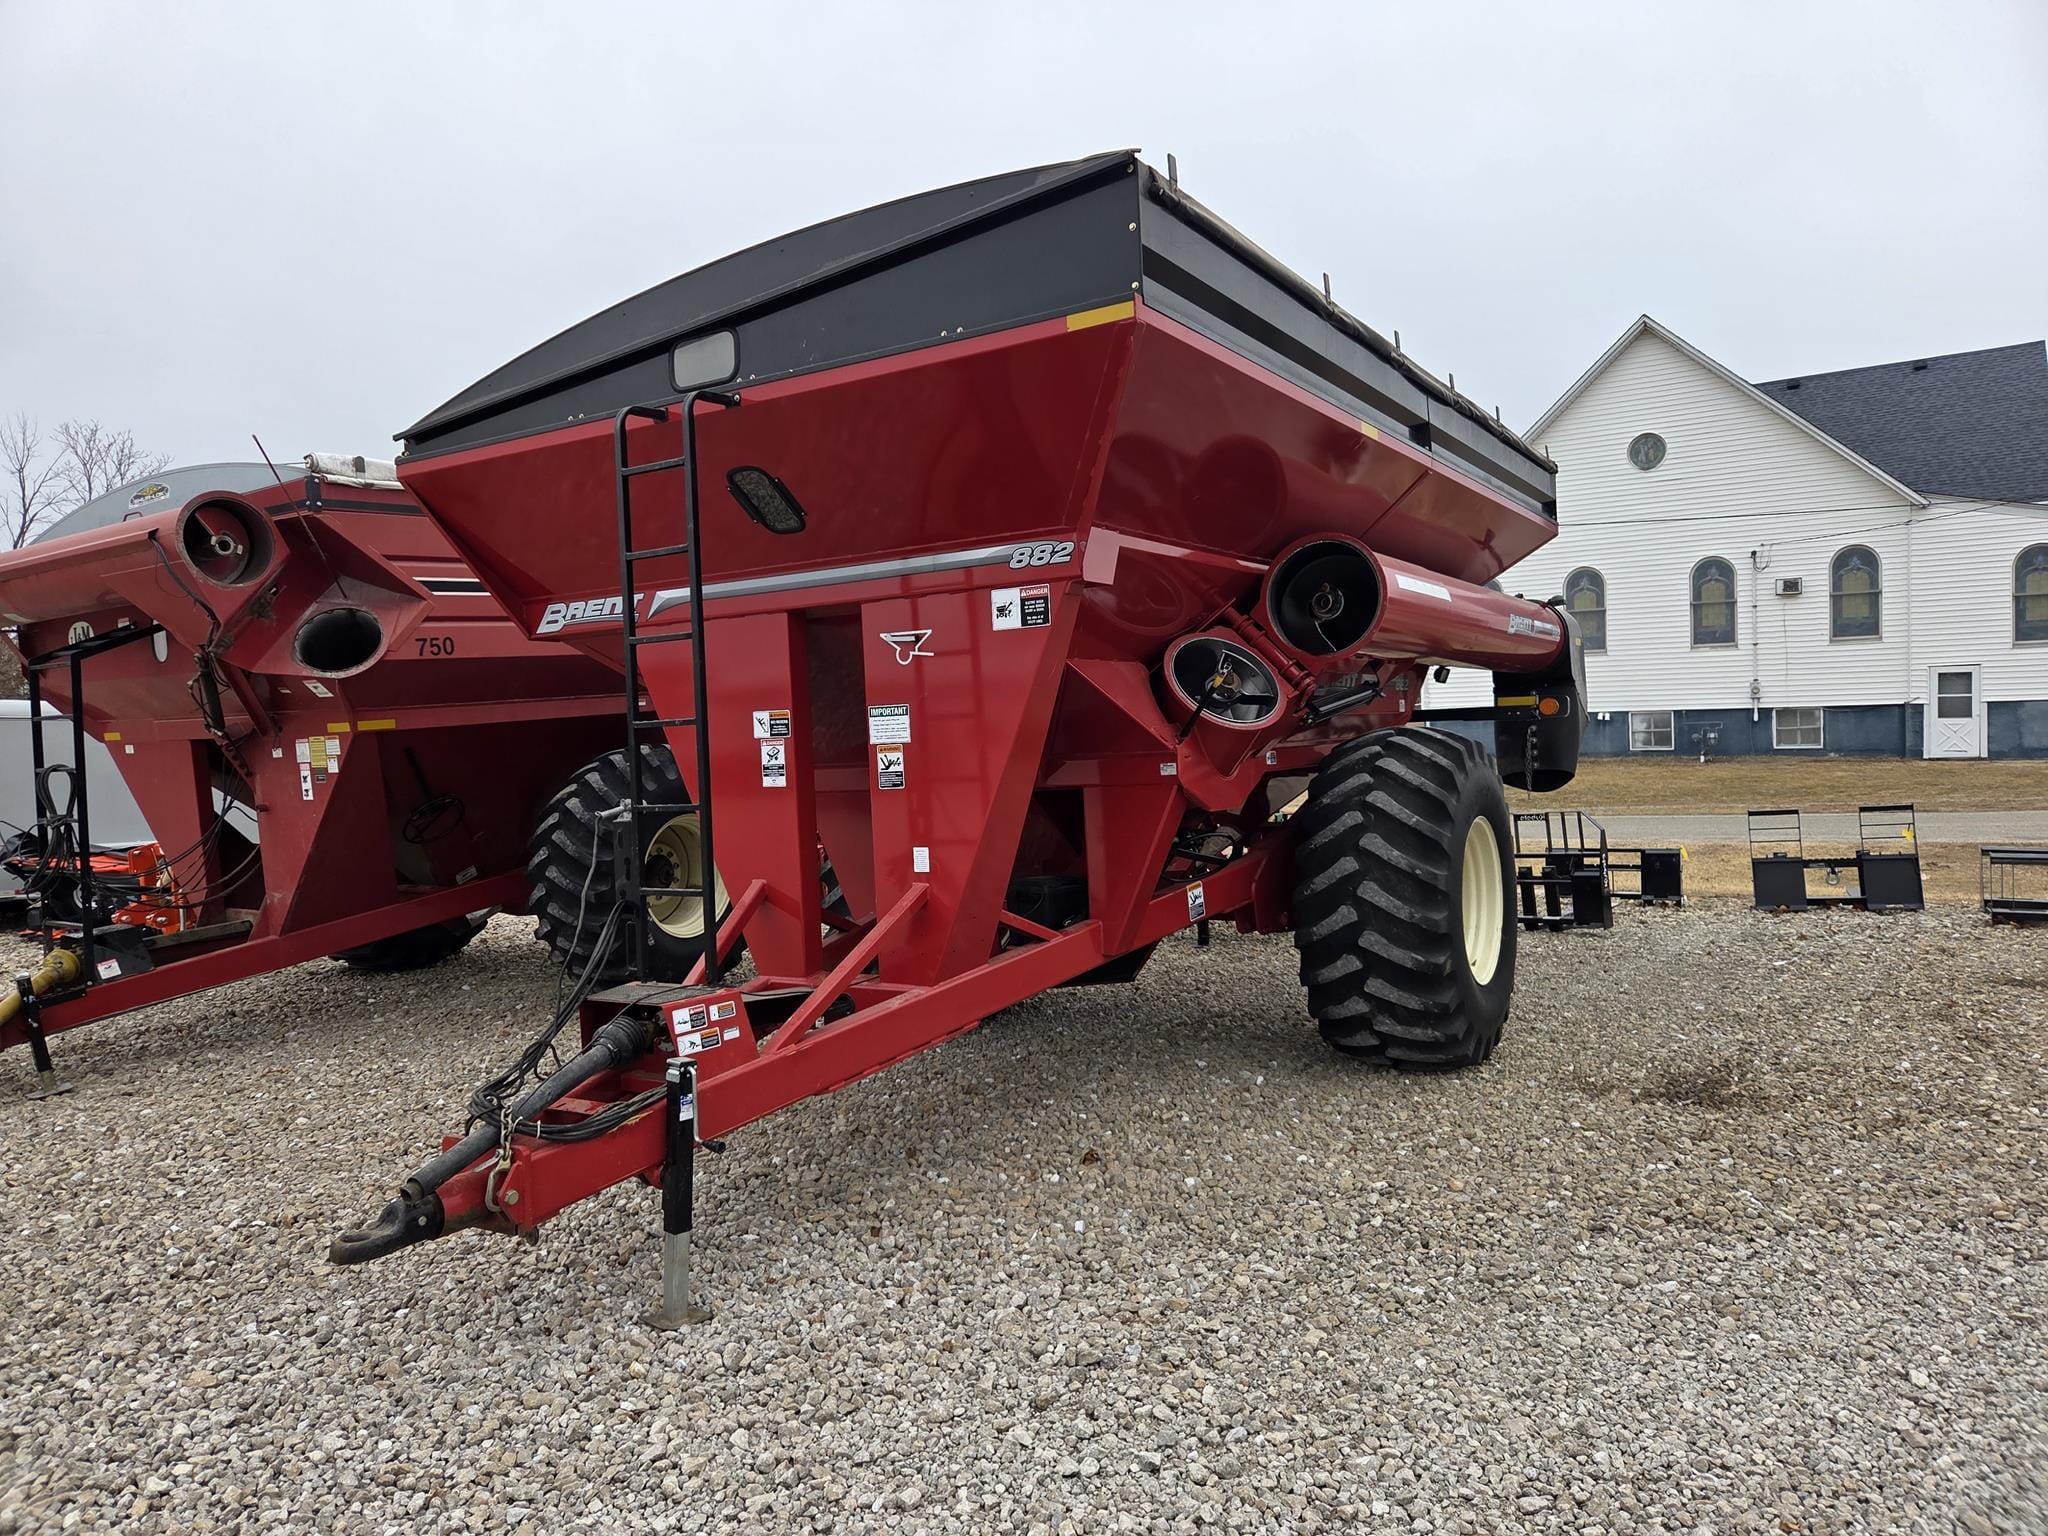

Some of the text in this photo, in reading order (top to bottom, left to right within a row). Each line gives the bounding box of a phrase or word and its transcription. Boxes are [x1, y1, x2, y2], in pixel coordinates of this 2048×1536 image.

[1009, 541, 1075, 569] 882
[415, 636, 455, 657] 750
[870, 706, 907, 716] IMPORTANT
